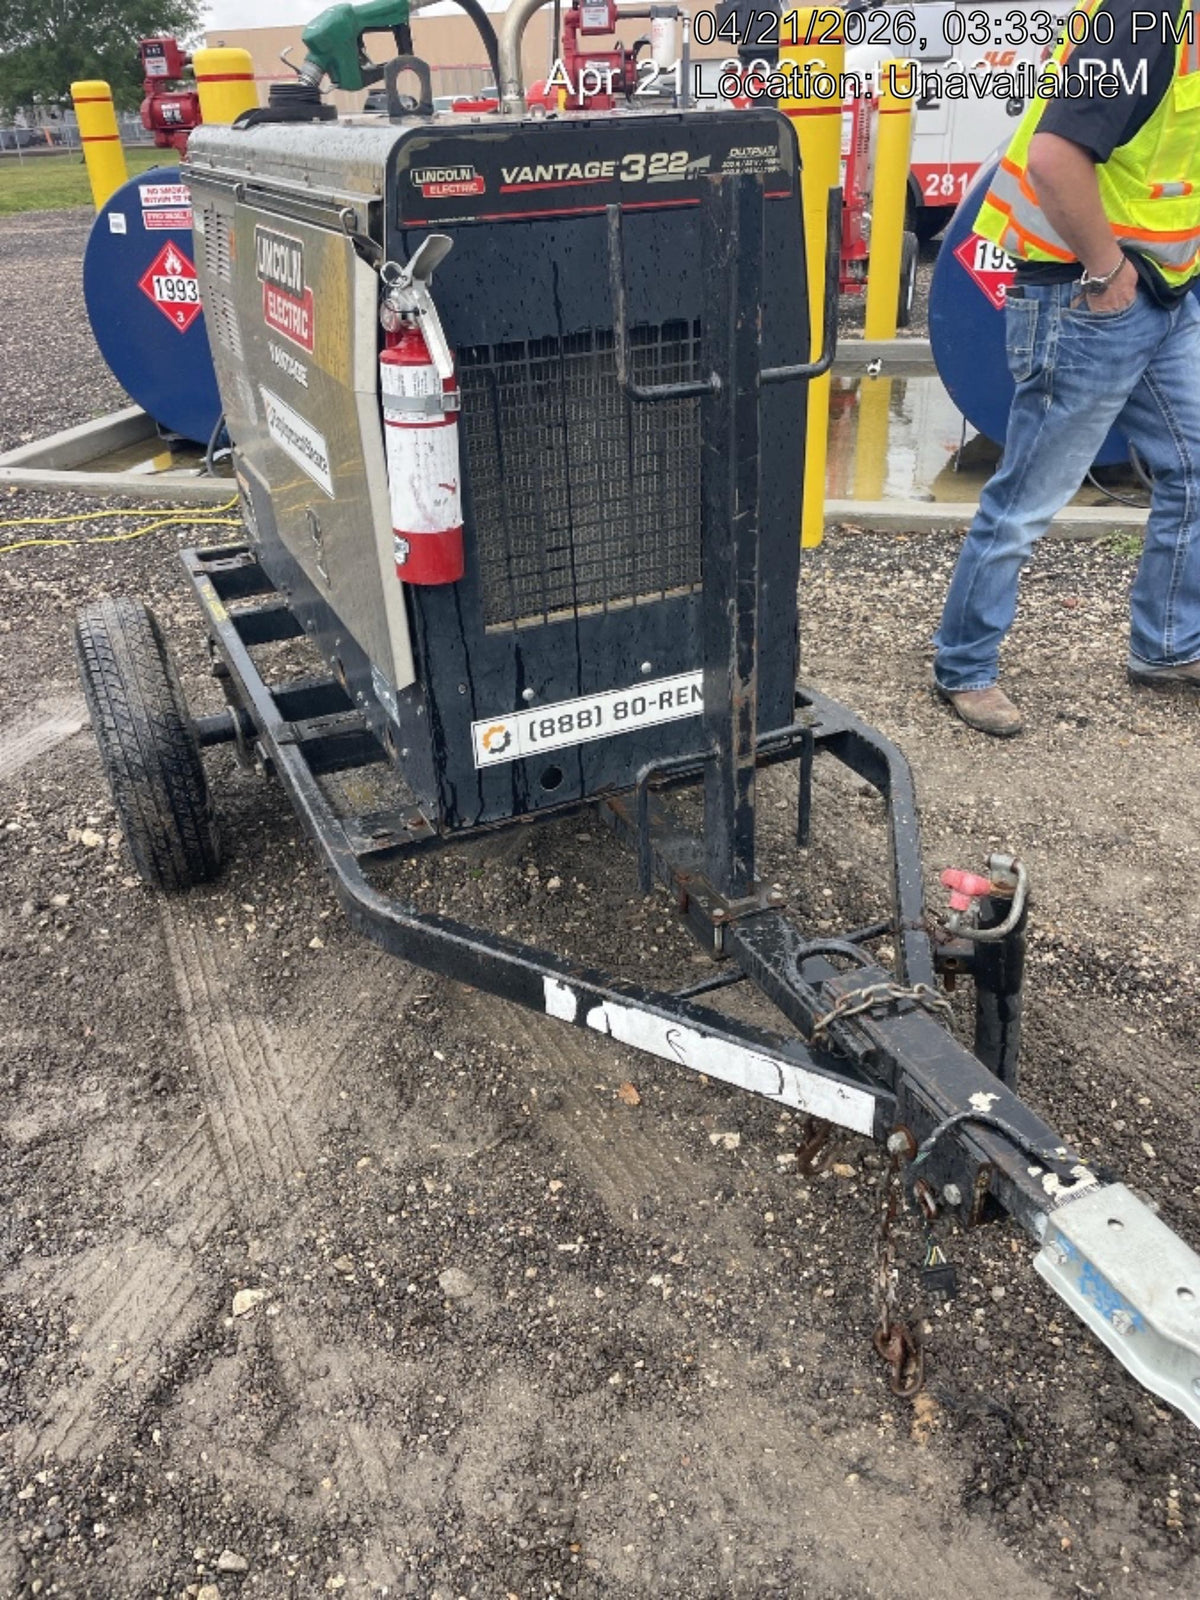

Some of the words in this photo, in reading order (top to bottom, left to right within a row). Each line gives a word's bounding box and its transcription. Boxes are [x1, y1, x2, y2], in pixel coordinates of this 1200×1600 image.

[415, 168, 471, 184] LINCOLN
[501, 159, 615, 184] VANTAGE
[620, 150, 690, 182] 322
[429, 182, 479, 195] ELECTRIC
[924, 172, 968, 197] 281
[256, 235, 302, 291] LINCOLN
[155, 276, 198, 302] 1993
[176, 310, 185, 323] 3
[268, 291, 309, 340] ELECTRIC
[529, 705, 602, 742] (888)
